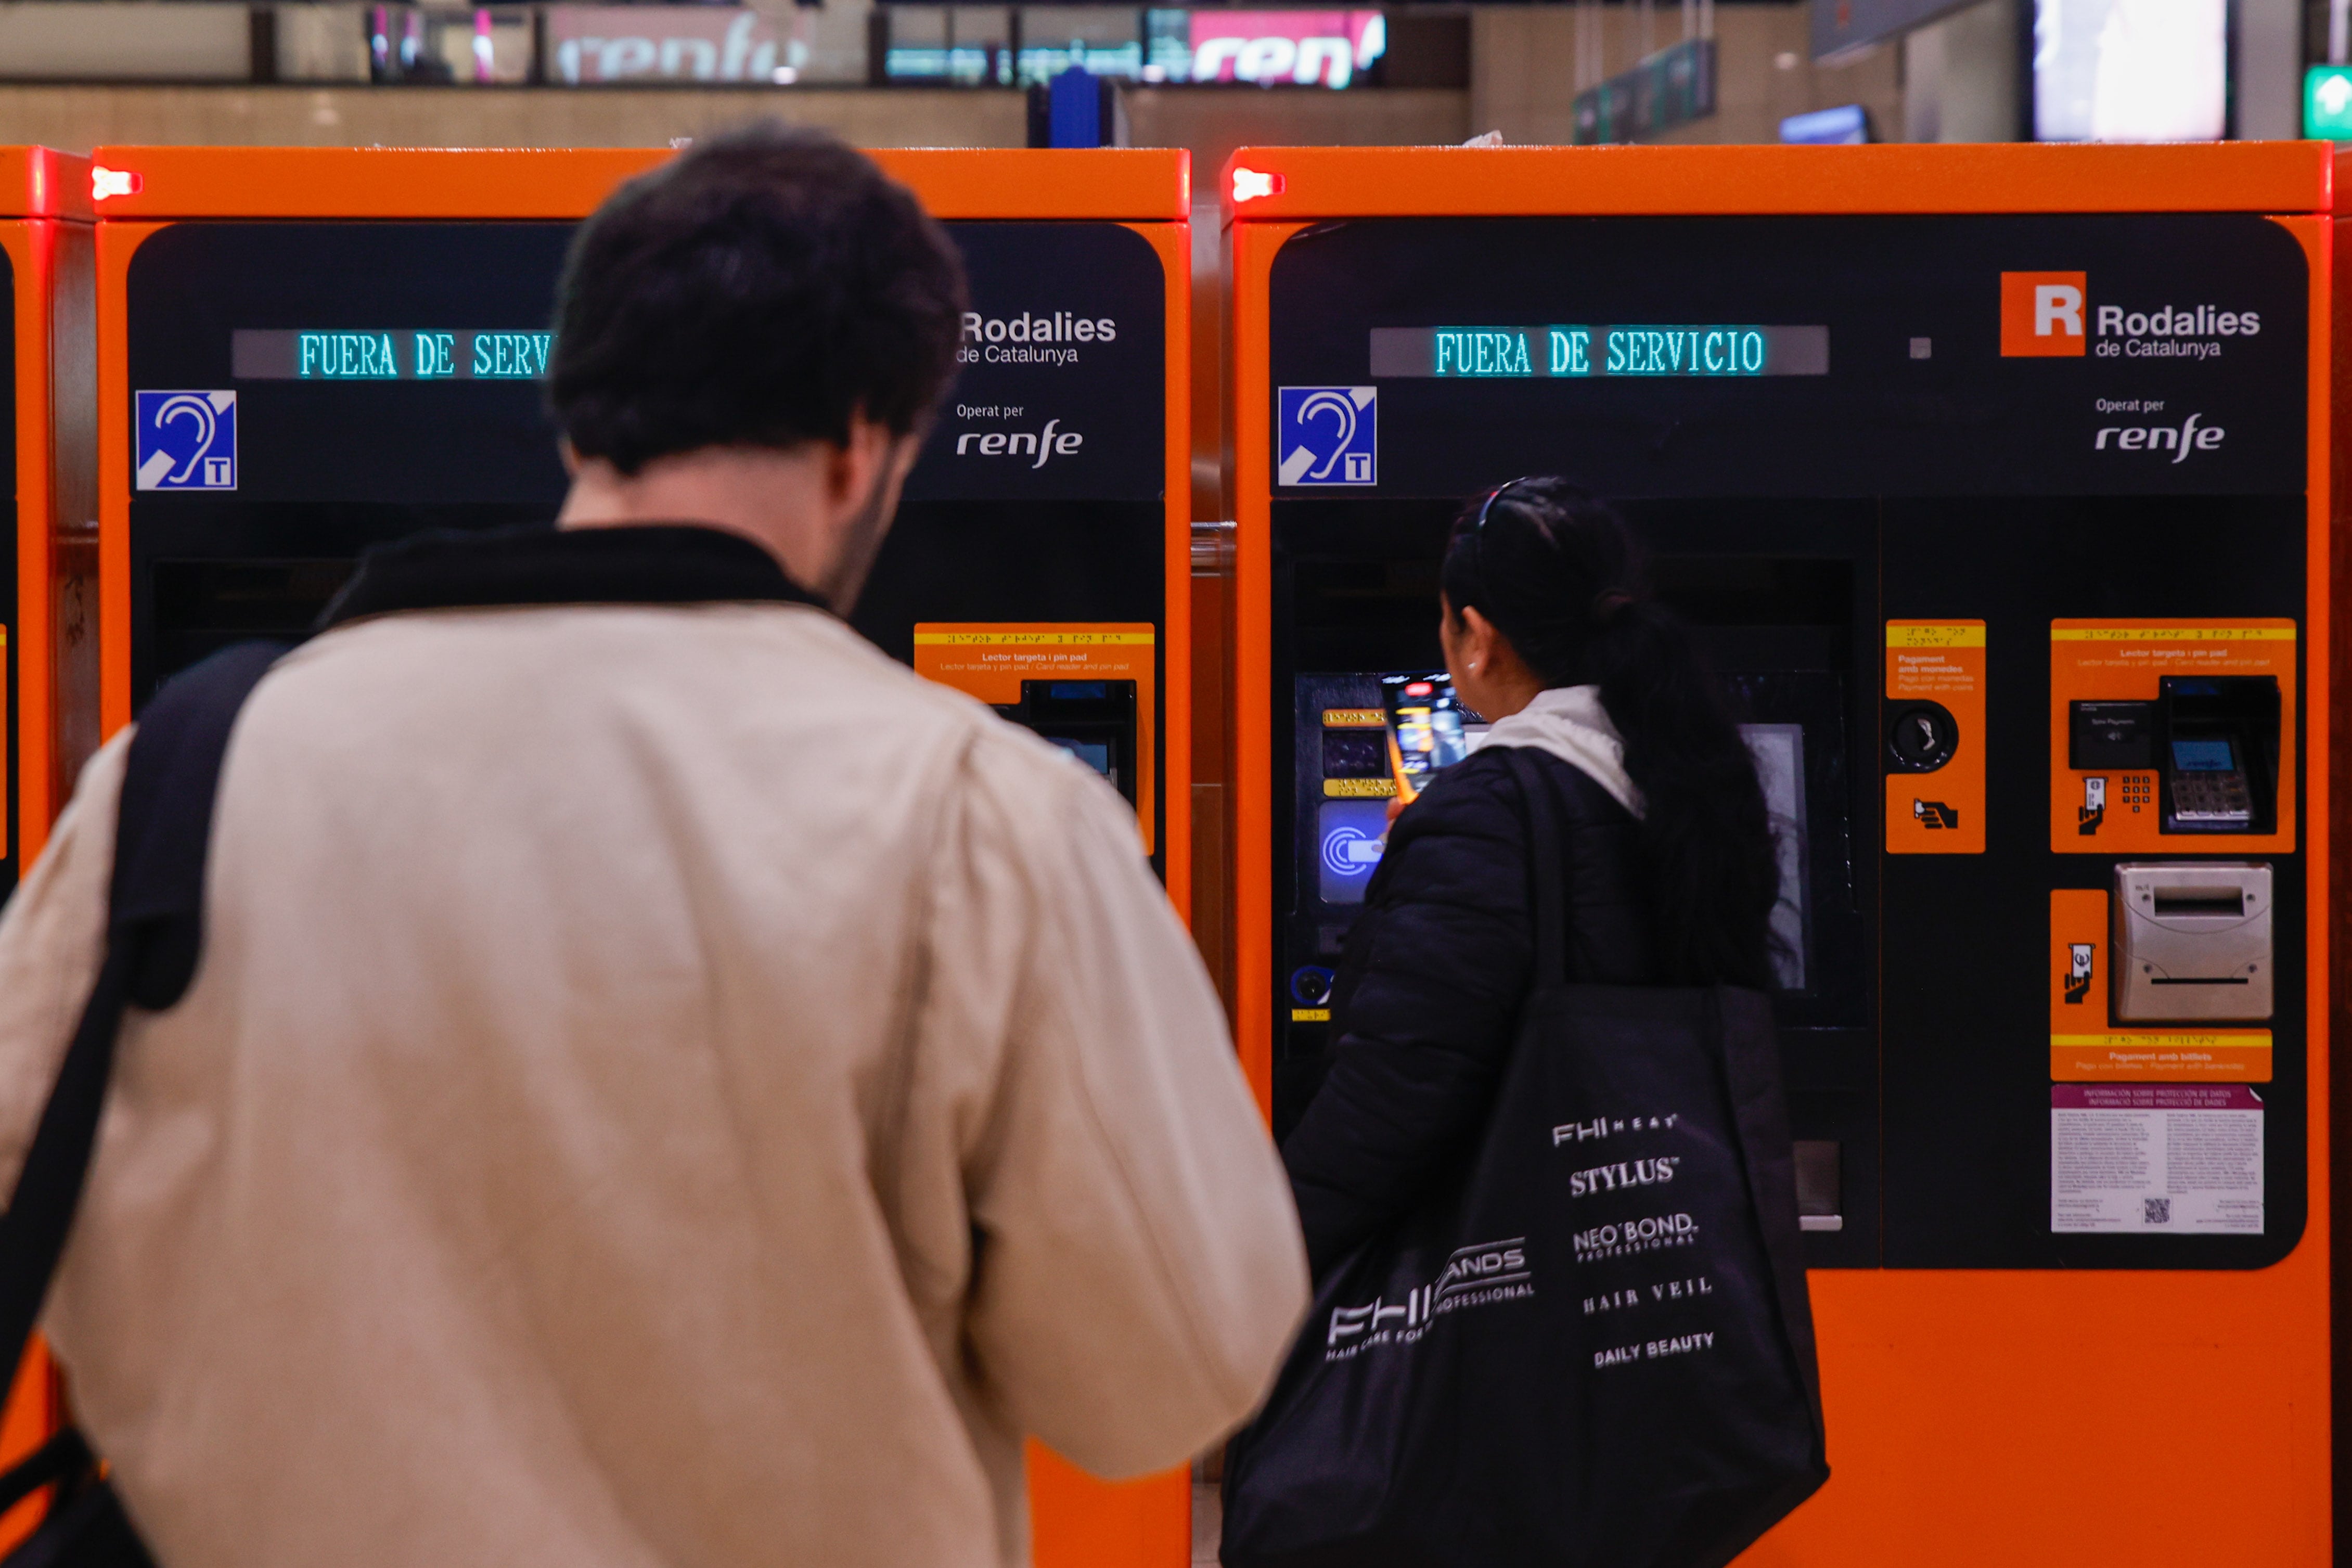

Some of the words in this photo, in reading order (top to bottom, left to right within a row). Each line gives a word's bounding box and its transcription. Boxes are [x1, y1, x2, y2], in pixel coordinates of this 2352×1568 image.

[2035, 285, 2082, 336] R
[2097, 305, 2260, 336] Rodalies
[961, 312, 1116, 342] Rodalies
[300, 335, 397, 375] FUERA
[416, 335, 454, 375] DE
[474, 335, 558, 375] SERV
[957, 346, 979, 363] de
[985, 345, 1078, 366] Catalunya
[1436, 332, 1531, 373] FUERA
[1551, 332, 1589, 373] DE
[1607, 331, 1762, 372] SERVICIO
[2096, 340, 2120, 357] de
[2126, 339, 2221, 360] Catalunya
[956, 404, 999, 420] Operat
[1004, 406, 1024, 420] per
[2096, 399, 2140, 414] Operat
[2143, 402, 2165, 414] per
[956, 418, 1084, 469] renfe
[2095, 413, 2225, 464] renfe
[210, 461, 227, 483] T
[1350, 456, 1367, 478] T
[982, 653, 1011, 661] Lector
[1014, 653, 1046, 664] targeta
[1053, 653, 1067, 664] pin
[1070, 653, 1087, 664] pad
[1552, 1116, 1608, 1148] FHI
[1445, 1248, 1526, 1280] ANDS
[1577, 1234, 1694, 1264] PROFESSIONAL
[1583, 1289, 1639, 1315] HAIR
[1651, 1277, 1713, 1302] VEIL
[1326, 1344, 1358, 1361] HAIR
[1360, 1329, 1390, 1351] CARE
[1594, 1344, 1640, 1369] DAILY
[1646, 1331, 1715, 1359] BEAUTY
